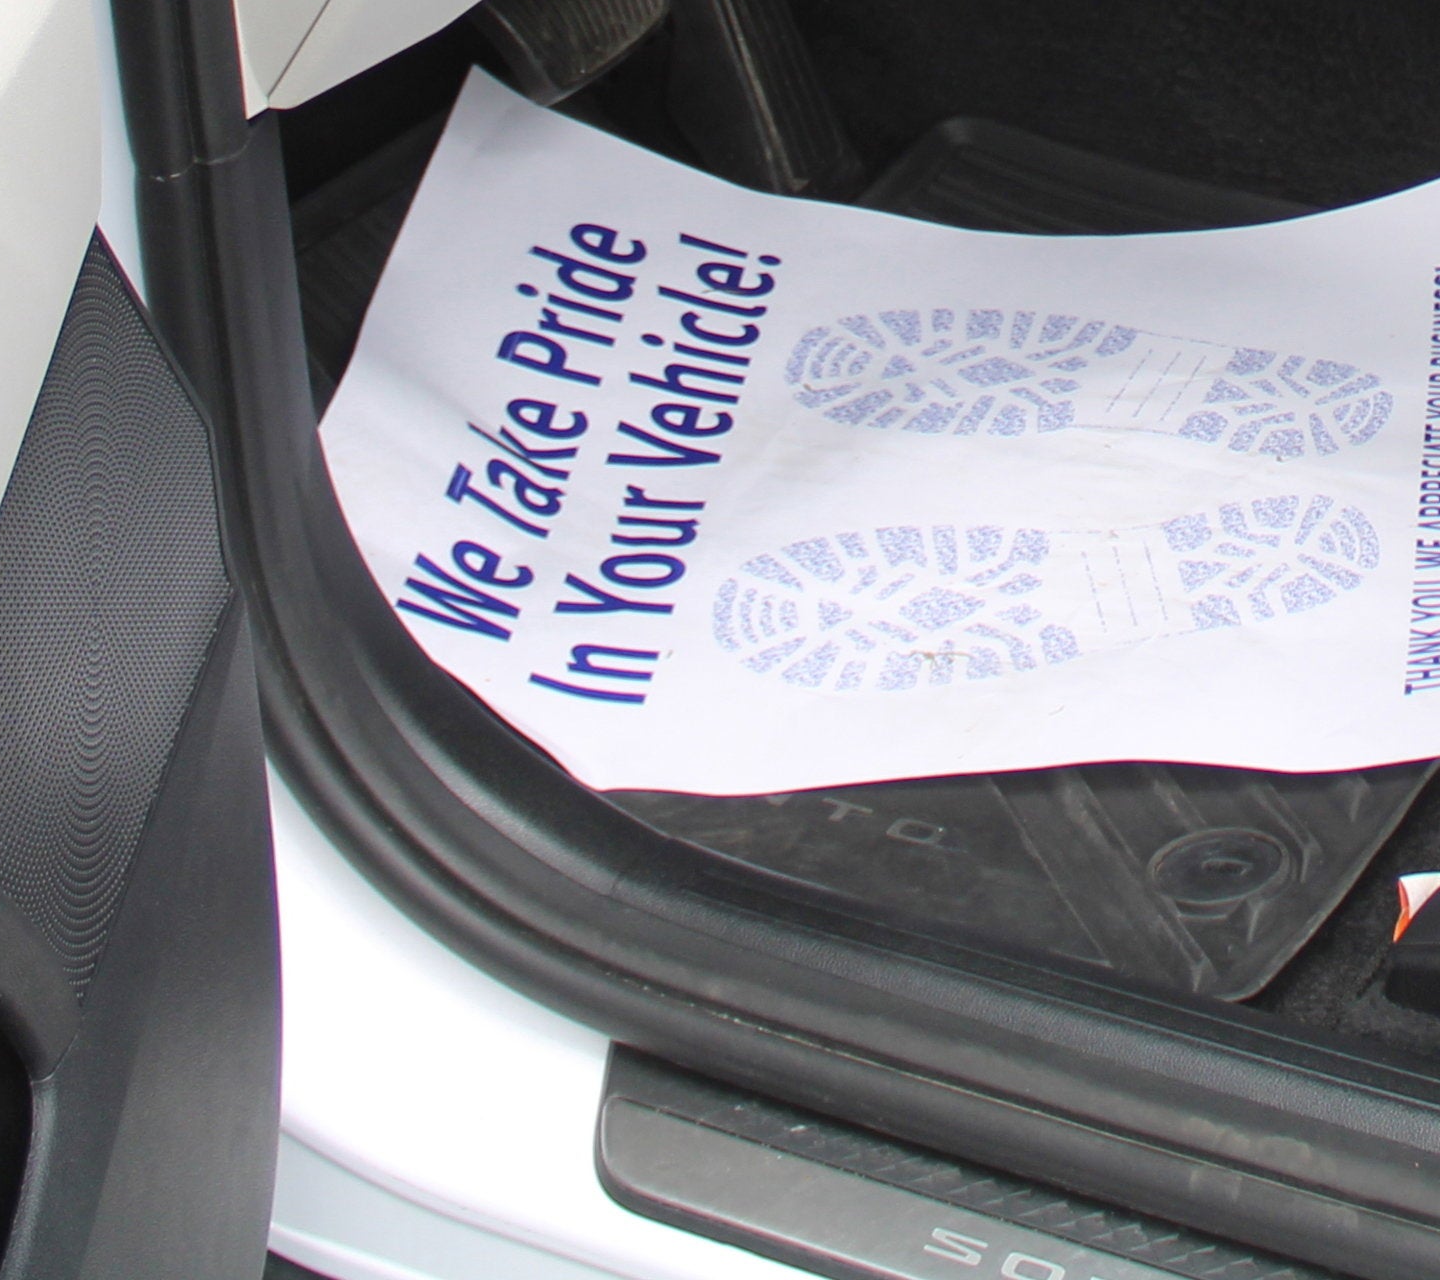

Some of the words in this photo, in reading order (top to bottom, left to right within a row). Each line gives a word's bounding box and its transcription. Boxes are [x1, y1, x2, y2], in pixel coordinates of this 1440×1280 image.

[496, 225, 645, 387] Pride
[606, 236, 781, 467] Vehicle!
[445, 400, 587, 539] Take
[395, 542, 533, 641] We
[554, 487, 704, 614] Your
[529, 645, 658, 704] In
[923, 1227, 1104, 1280] SO
